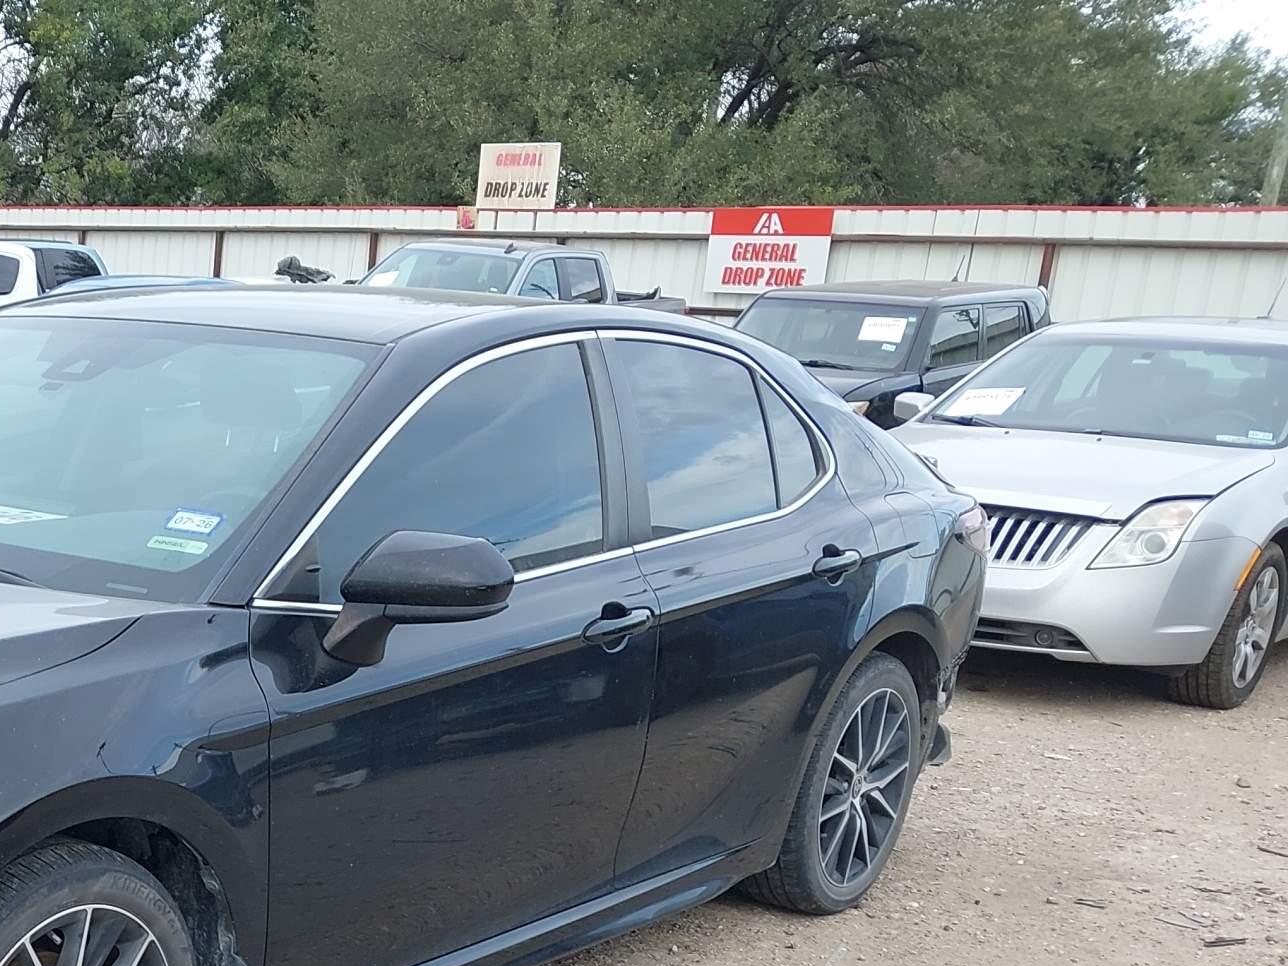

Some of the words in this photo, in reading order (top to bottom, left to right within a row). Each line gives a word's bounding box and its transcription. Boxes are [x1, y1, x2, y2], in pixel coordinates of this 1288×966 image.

[496, 153, 544, 167] GENERAL
[483, 181, 517, 199] DROP
[518, 181, 550, 199] ZONE
[731, 242, 798, 262] GENERAL
[721, 266, 765, 286] DROP
[765, 268, 807, 287] ZONE
